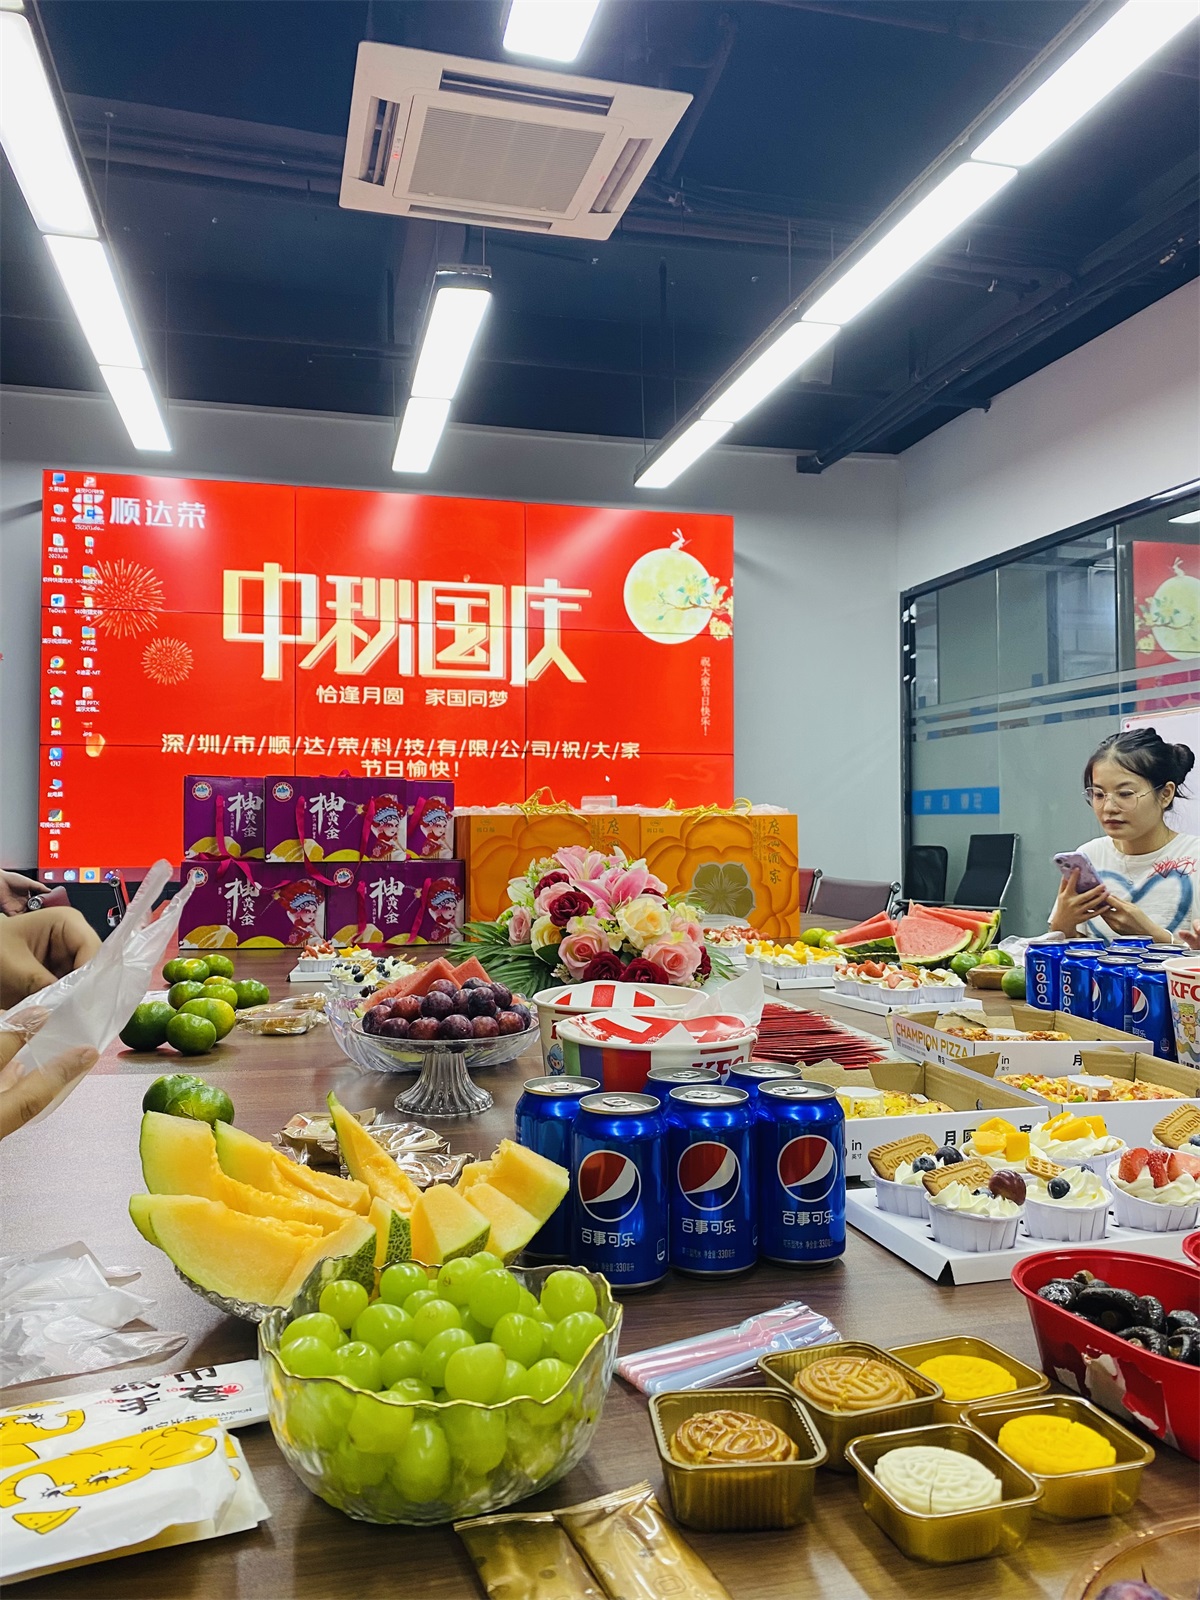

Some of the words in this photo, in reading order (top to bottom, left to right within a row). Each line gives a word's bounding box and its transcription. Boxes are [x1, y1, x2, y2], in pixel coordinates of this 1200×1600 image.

[109, 496, 206, 529] 顺达荣
[222, 562, 592, 687] 中秋国庆
[316, 684, 404, 706] 恰逢月圆
[425, 688, 509, 708] 家国同梦
[1033, 959, 1051, 1006] pepsi
[895, 1022, 938, 1051] CHAMPION
[940, 1039, 968, 1058] PIZZA
[1001, 1055, 1010, 1065] in
[851, 1139, 862, 1150] in
[681, 1217, 737, 1236] 百事可乐
[782, 1209, 835, 1226] 百事可乐
[581, 1227, 636, 1248] 百事可乐
